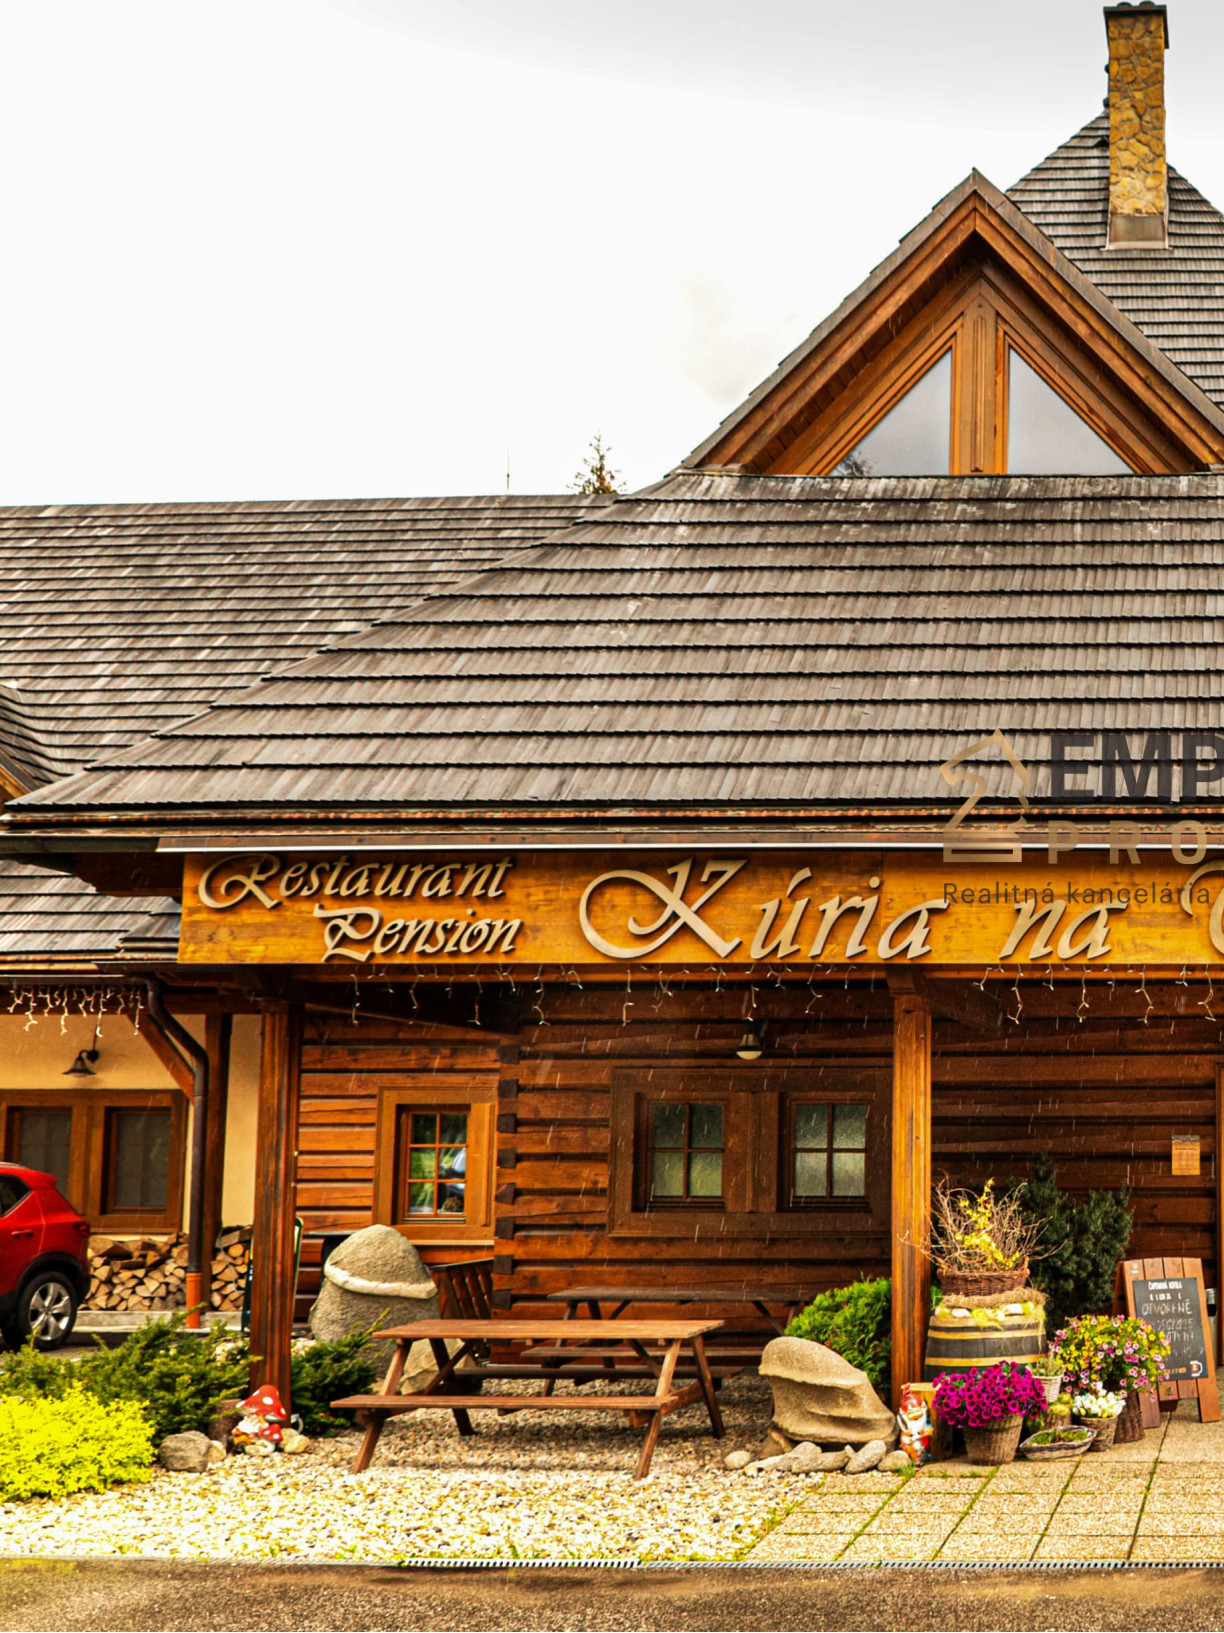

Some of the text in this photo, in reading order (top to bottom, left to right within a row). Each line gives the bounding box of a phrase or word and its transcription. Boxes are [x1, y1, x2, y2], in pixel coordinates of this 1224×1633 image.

[198, 853, 513, 909] Restaurant
[579, 859, 949, 960] Kúria
[999, 899, 1130, 960] na
[313, 903, 522, 962] Pension
